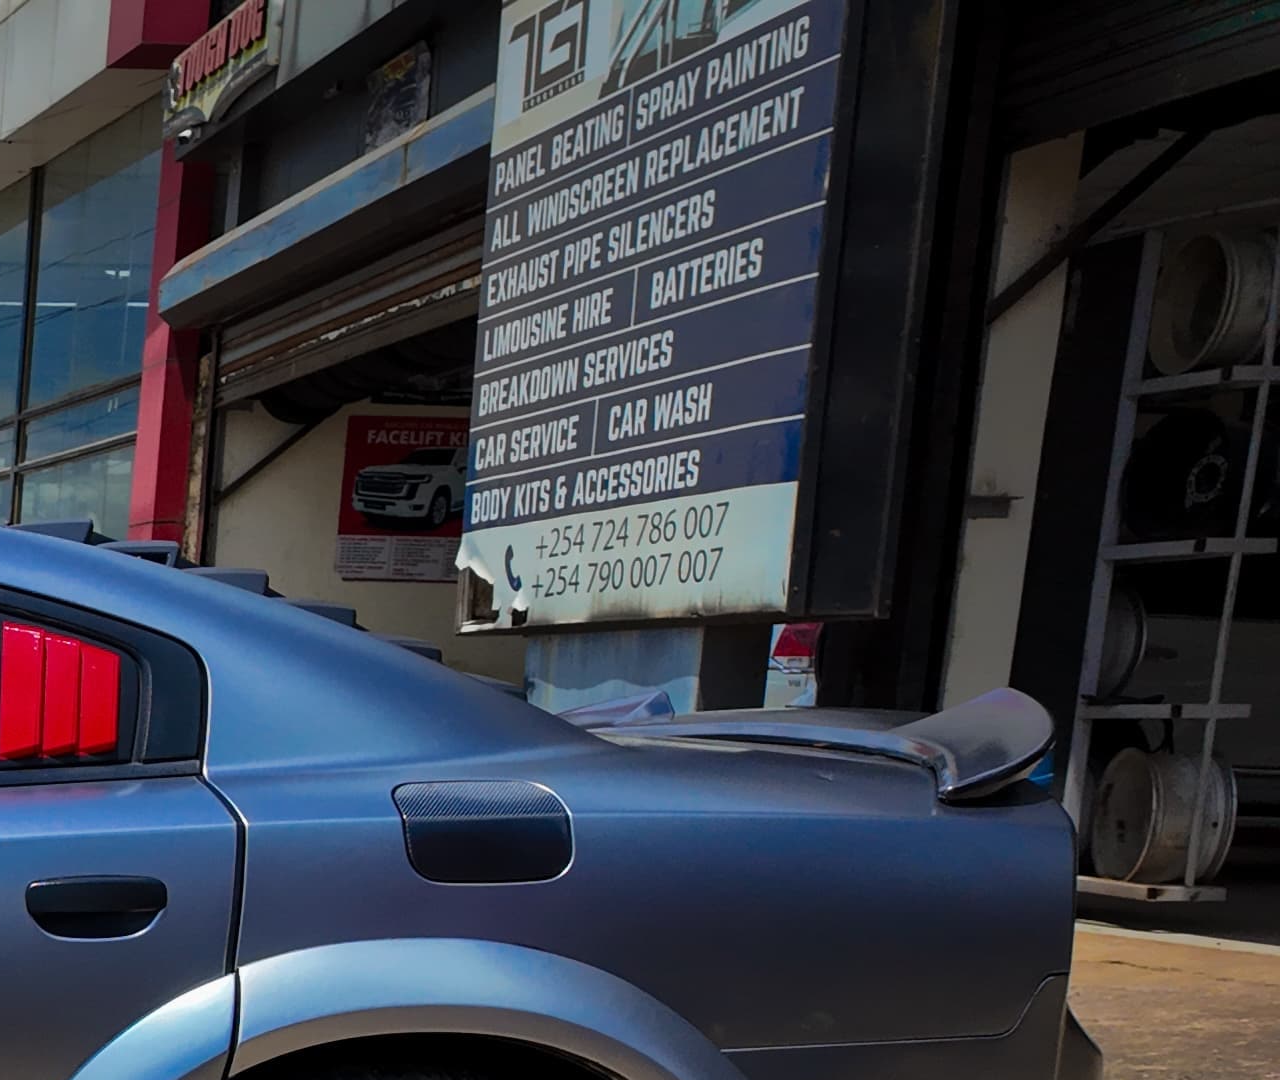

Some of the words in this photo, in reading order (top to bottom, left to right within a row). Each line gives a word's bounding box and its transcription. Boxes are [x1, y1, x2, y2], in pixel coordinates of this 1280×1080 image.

[175, 18, 229, 98] TOUGH
[228, 0, 266, 59] DOG
[635, 66, 702, 131] SPRAY
[705, 15, 811, 100] PAINTING
[491, 210, 522, 253] ALL
[527, 157, 640, 237] WINDSCREEN
[643, 86, 806, 190] REPLACEMENT
[494, 143, 546, 197] PANEL
[550, 104, 625, 172] BEATING
[486, 249, 560, 308] EXHAUST
[562, 232, 604, 280] PIPE
[607, 189, 717, 264] SILENCERS
[650, 237, 765, 310] BATTERIES
[483, 303, 569, 362] LIMOUSINE
[572, 288, 614, 335] HIRE
[478, 353, 578, 418] BREAKDOWN
[583, 329, 675, 390] SERVICES
[366, 428, 446, 446] FACELIFT
[449, 430, 468, 447] KI
[474, 432, 506, 472] CAR
[510, 414, 580, 464] SERVICE
[608, 397, 648, 442] CAR
[653, 382, 713, 433] WASH
[470, 484, 512, 525] BODY
[513, 475, 551, 519] KITS
[553, 474, 567, 510] &
[571, 449, 701, 507] ACCESSORIES
[535, 523, 585, 560] +254
[591, 516, 629, 554] 724
[636, 509, 677, 547] 786
[683, 501, 730, 539] 007
[531, 563, 580, 599] +254
[586, 559, 625, 594] 790
[630, 553, 672, 588] 007
[678, 546, 724, 583] 007
